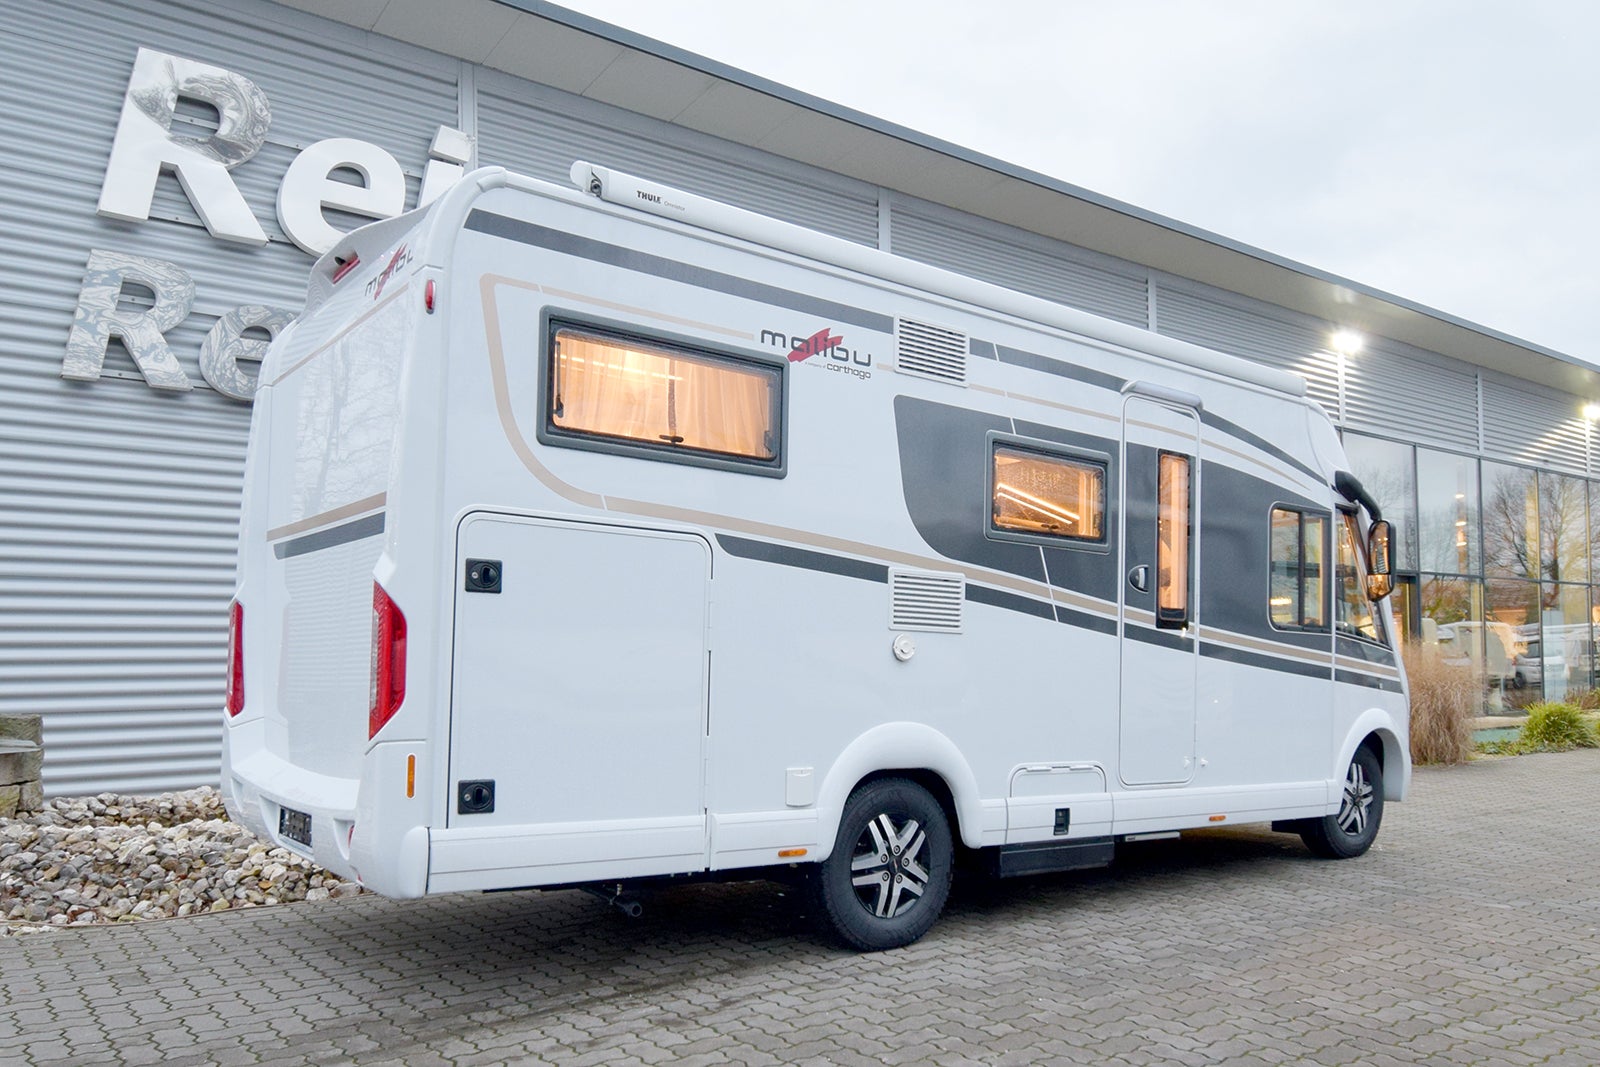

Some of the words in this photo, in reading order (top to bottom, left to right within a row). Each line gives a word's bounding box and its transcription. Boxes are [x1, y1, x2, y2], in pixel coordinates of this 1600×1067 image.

[636, 190, 661, 205] THULE
[760, 328, 872, 367] malibu
[826, 362, 872, 380] carthago
